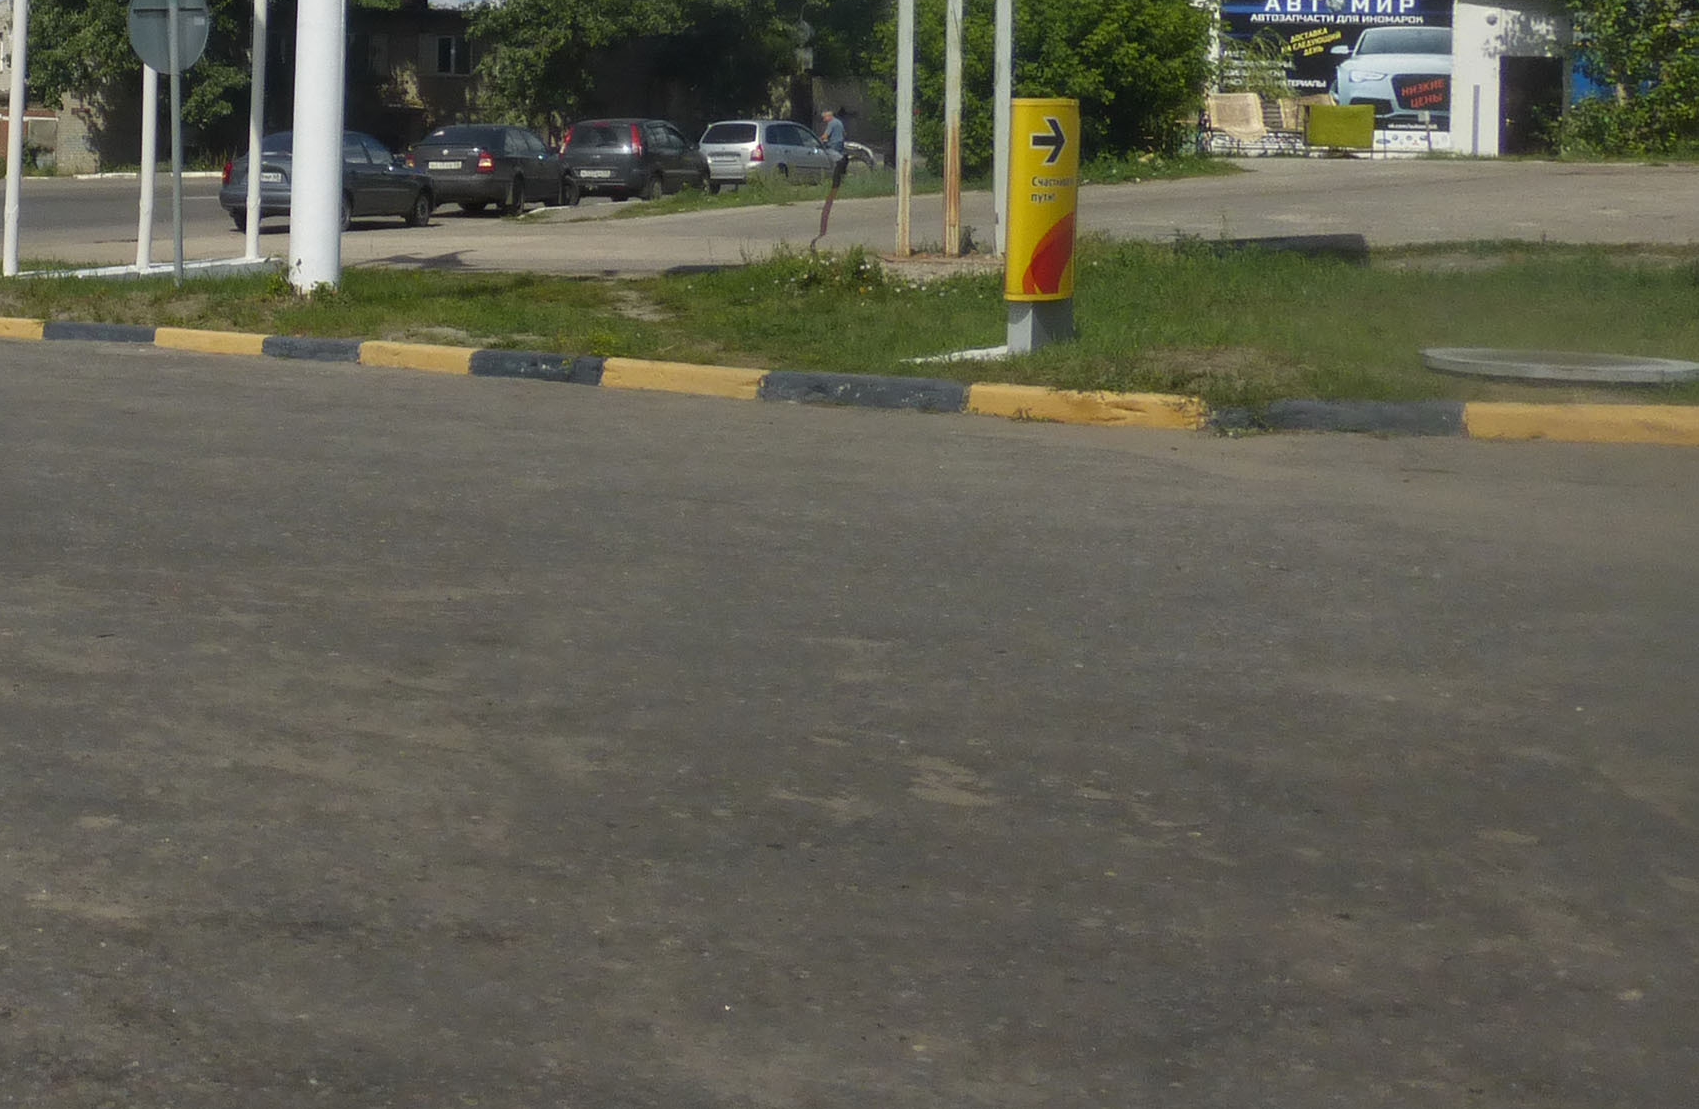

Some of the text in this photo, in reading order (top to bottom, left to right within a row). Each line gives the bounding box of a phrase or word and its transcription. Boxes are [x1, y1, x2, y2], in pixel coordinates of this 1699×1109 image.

[1249, 13, 1424, 24] АВТОЗАПЧАСТИ ДЛЯ ИНОМАРОК
[1400, 78, 1445, 97] НИЗКИЕ
[1409, 93, 1443, 109] ЦЕНЫ
